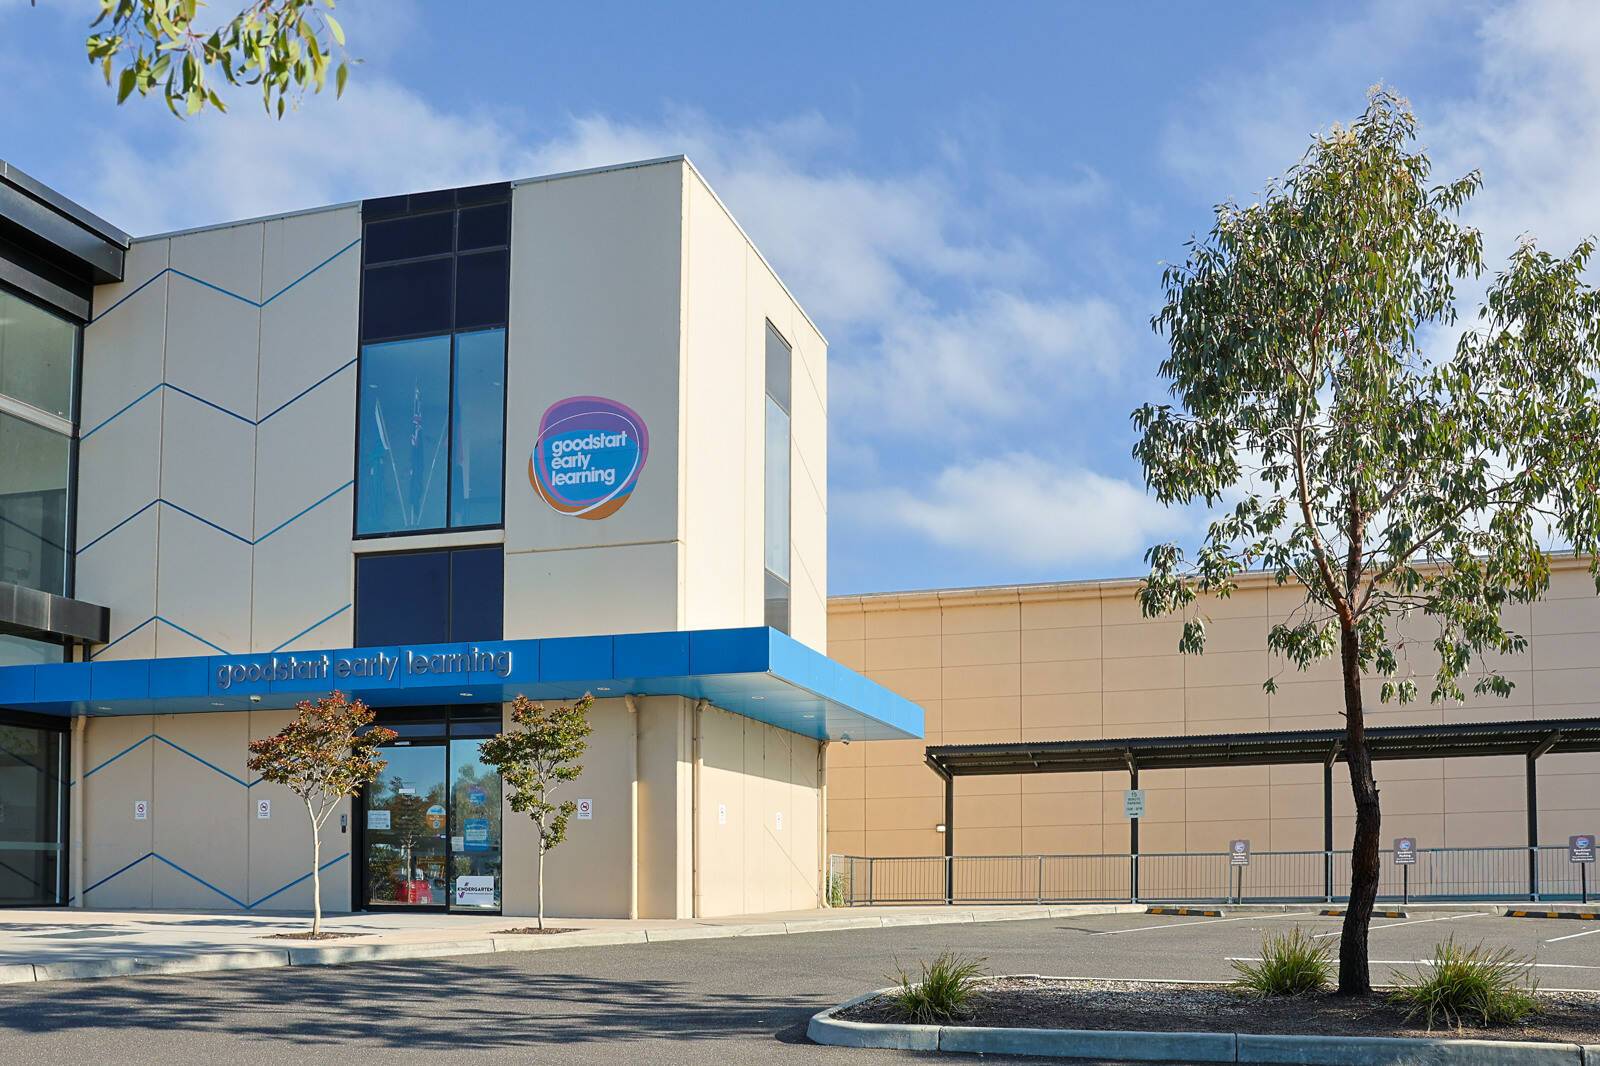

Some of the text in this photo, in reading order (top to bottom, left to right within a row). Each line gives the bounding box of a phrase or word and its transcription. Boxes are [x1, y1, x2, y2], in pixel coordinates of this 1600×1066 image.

[552, 430, 627, 457] goodstart
[551, 452, 592, 470] early
[552, 467, 615, 486] learning
[216, 646, 513, 690] goodstart early learning
